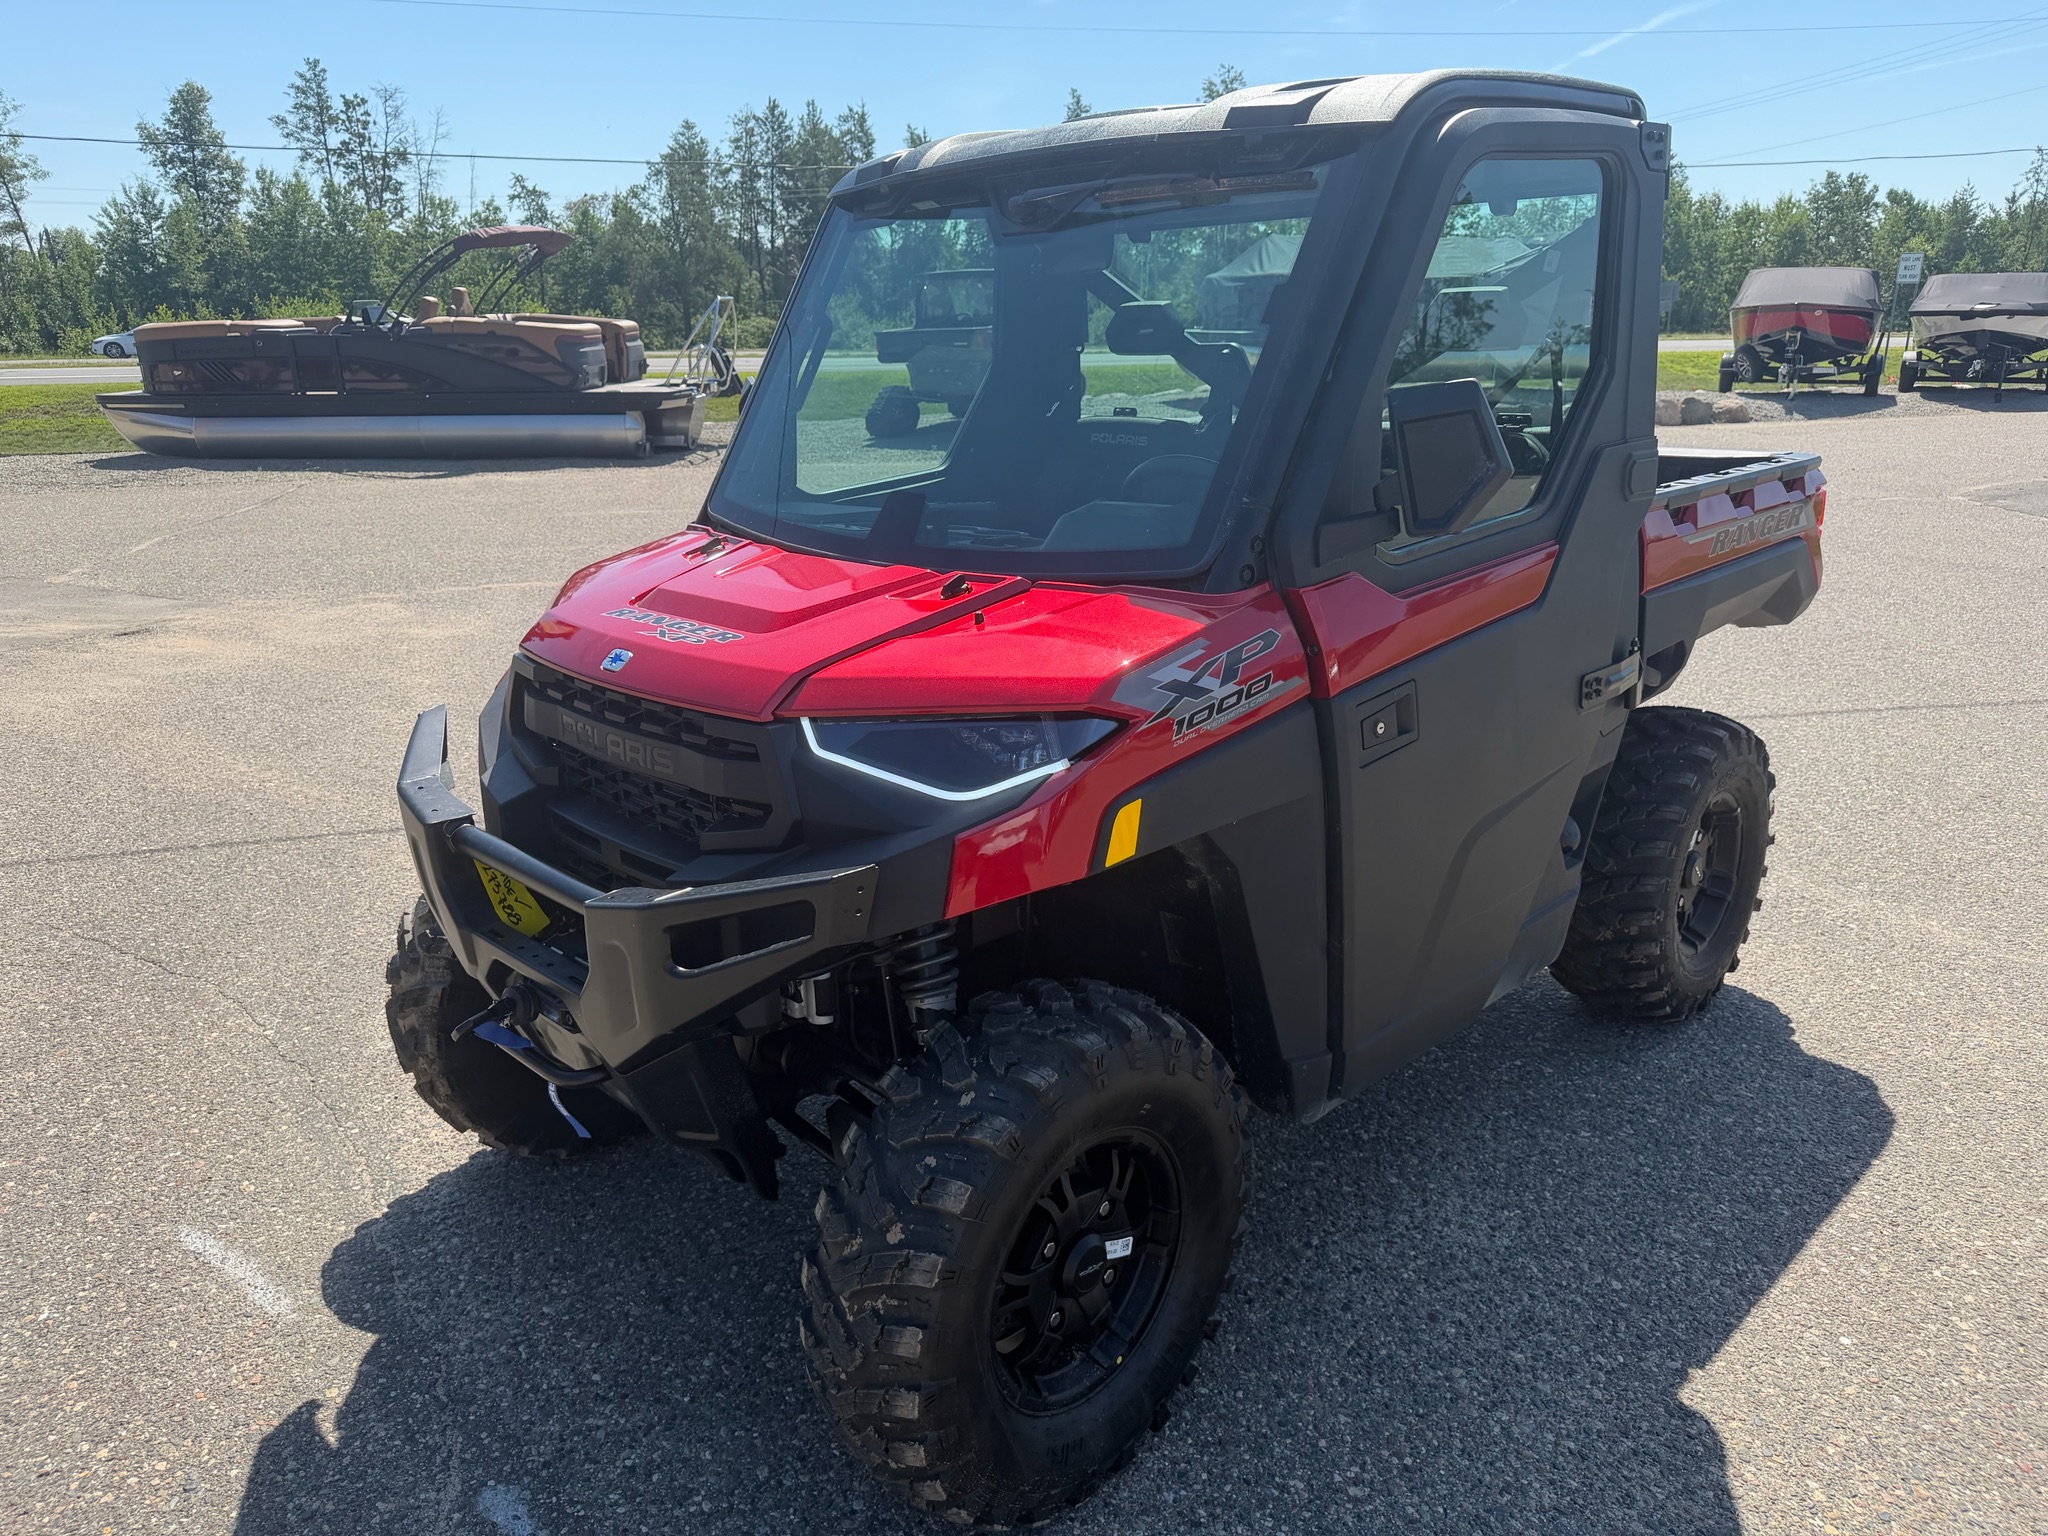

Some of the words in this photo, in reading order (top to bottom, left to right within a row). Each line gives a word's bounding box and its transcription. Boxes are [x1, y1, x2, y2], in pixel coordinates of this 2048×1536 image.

[1090, 433, 1149, 446] POLARIS
[1708, 503, 1805, 558] RANGER
[600, 607, 744, 643] RANGER
[635, 627, 706, 644] XP
[1136, 628, 1281, 733] XP
[1172, 671, 1274, 740] 1000
[561, 714, 675, 776] POLARIS
[1173, 731, 1199, 747] DUAL
[1200, 704, 1249, 734] OVERHEAD
[1250, 692, 1270, 707] CAM
